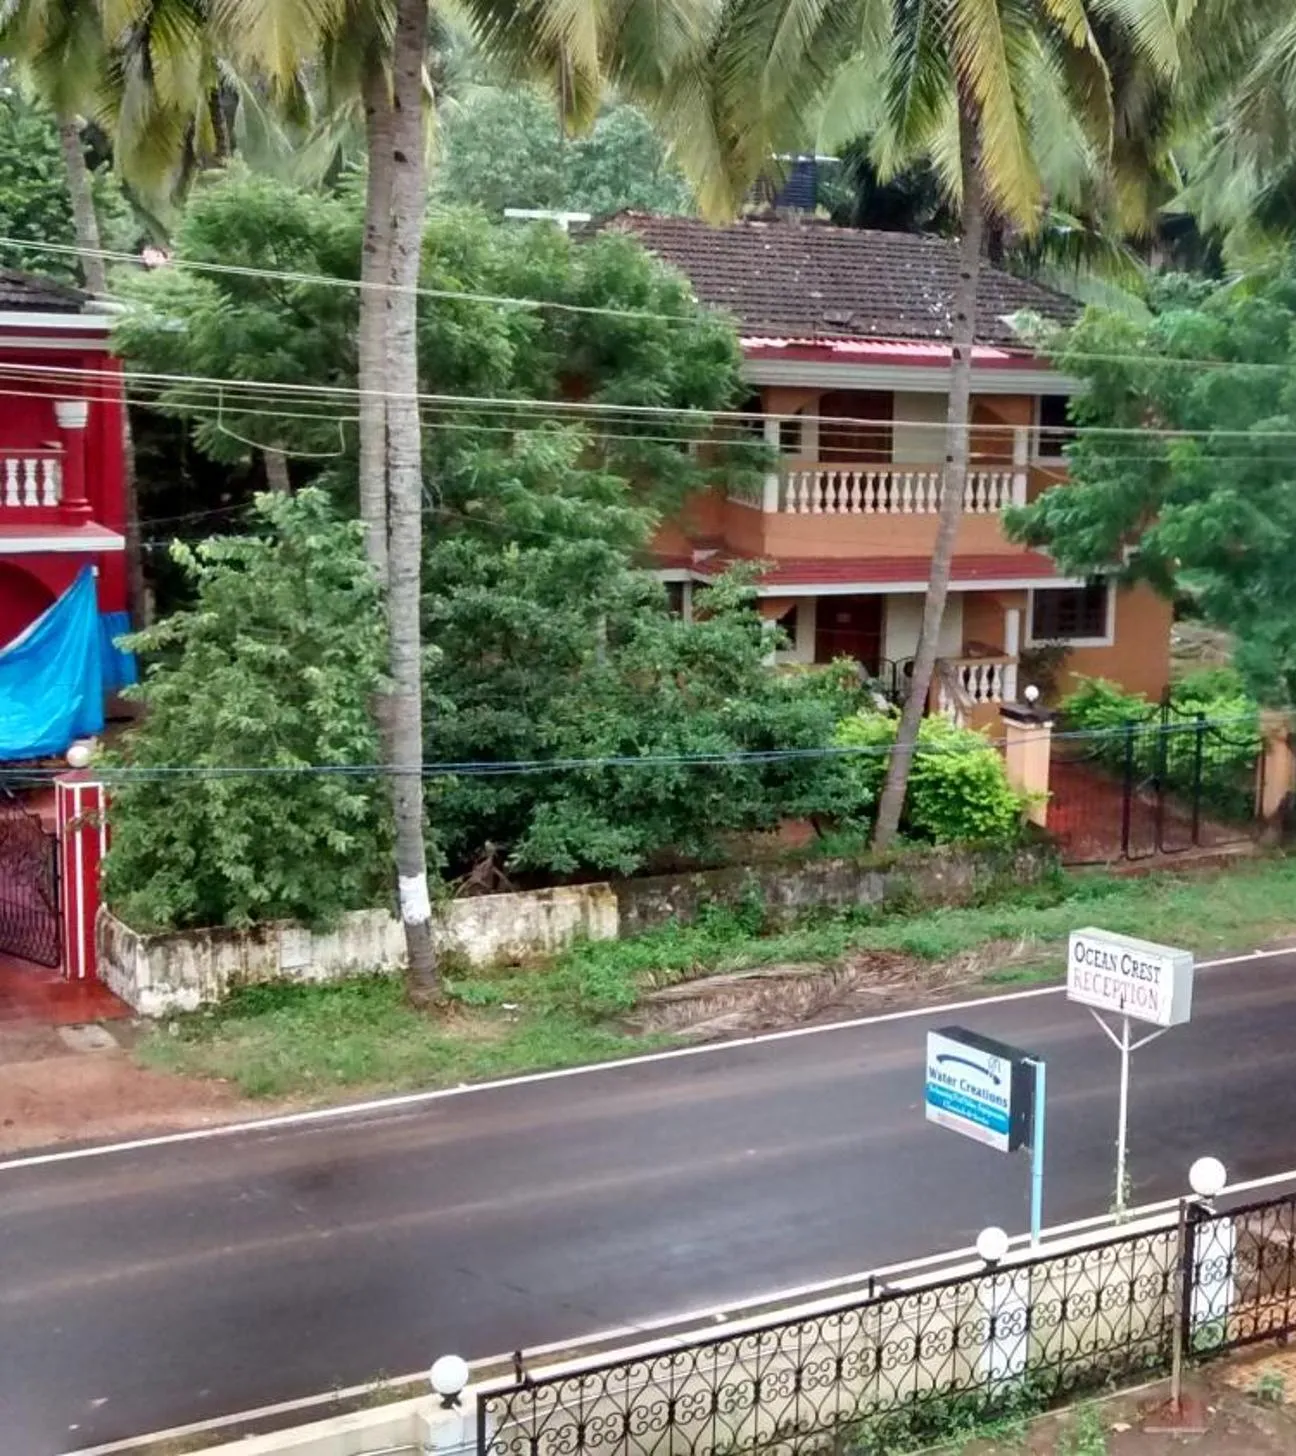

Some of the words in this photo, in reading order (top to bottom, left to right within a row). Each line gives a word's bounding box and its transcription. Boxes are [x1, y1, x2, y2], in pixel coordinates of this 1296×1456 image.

[1074, 942, 1118, 972] OCEAN
[1121, 954, 1161, 984] CREST
[1074, 967, 1158, 1011] RECEPTION
[928, 1066, 957, 1087] Water
[959, 1078, 1008, 1108] Creations
